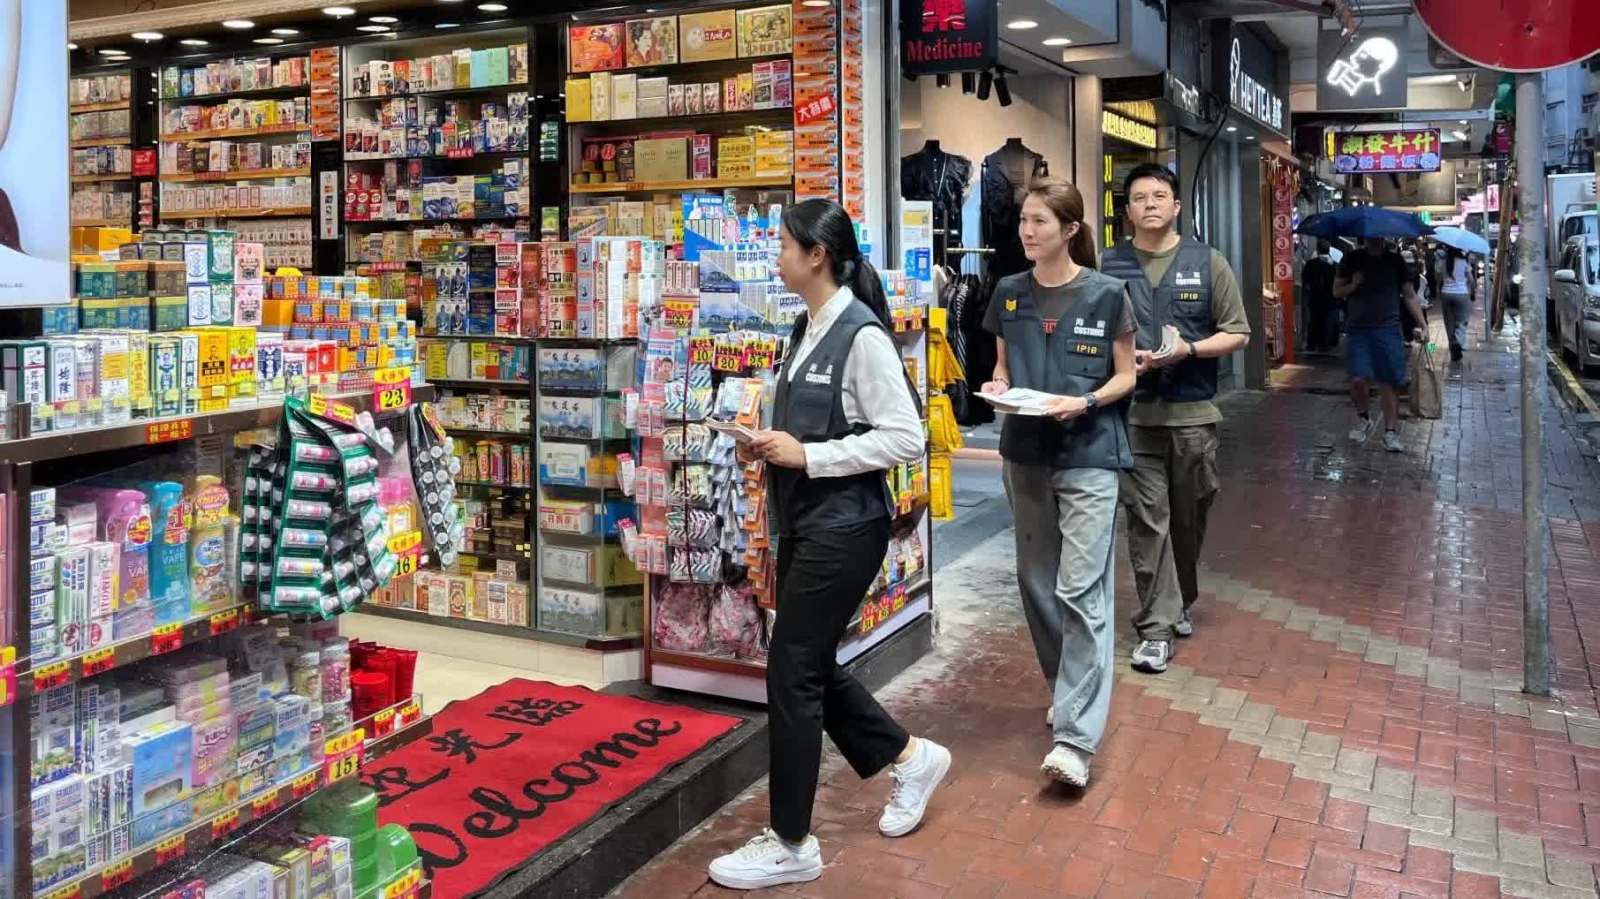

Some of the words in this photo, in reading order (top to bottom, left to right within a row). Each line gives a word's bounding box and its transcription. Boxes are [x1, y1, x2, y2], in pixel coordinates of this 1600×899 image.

[907, 37, 983, 62] Medicine
[721, 359, 735, 369] 20
[385, 388, 404, 409] 23
[335, 756, 353, 778] 15
